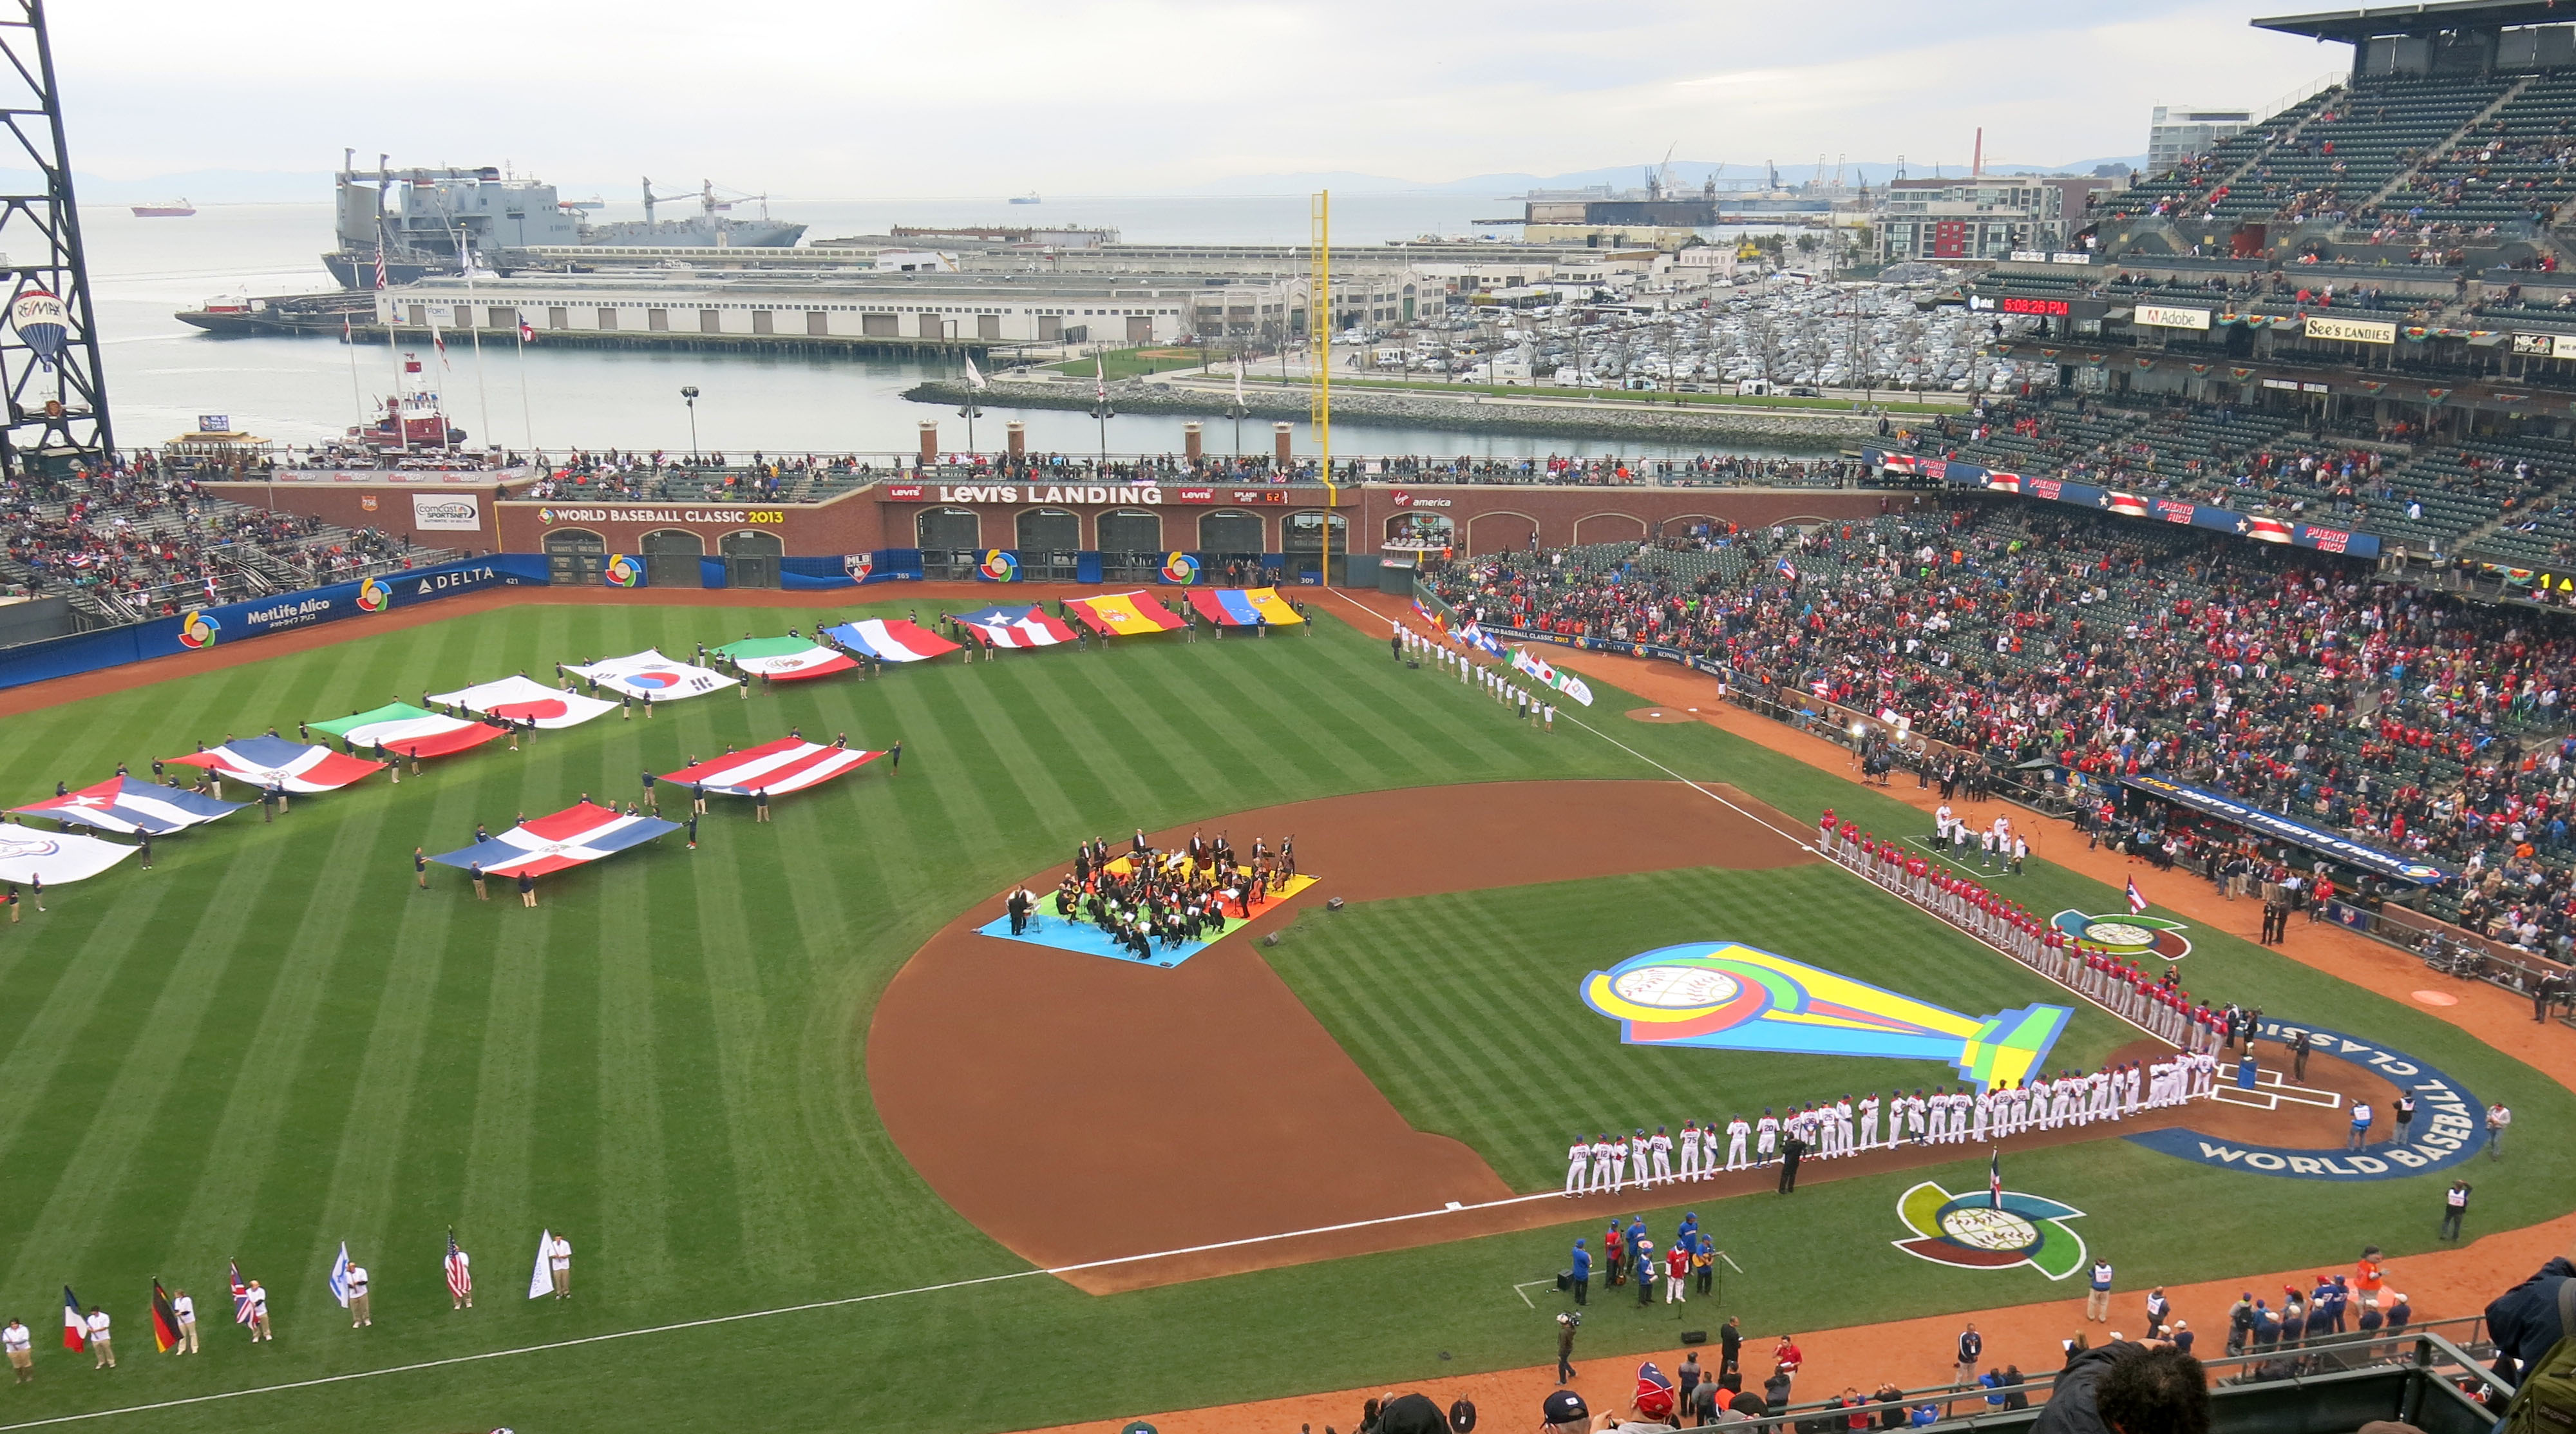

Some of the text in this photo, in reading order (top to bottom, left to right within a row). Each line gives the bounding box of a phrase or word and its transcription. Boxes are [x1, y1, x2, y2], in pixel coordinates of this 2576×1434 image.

[17, 300, 62, 318] RE/MAX
[2004, 298, 2069, 315] 5:08:26 PM
[2161, 311, 2195, 326] Adobe
[2309, 320, 2390, 341] See's CANDIES
[2515, 335, 2537, 346] NBC
[1919, 459, 1947, 471] PUERTO
[1927, 469, 1944, 479] RICO
[2029, 477, 2061, 492] PUERTO
[1028, 486, 1162, 504] LANDING
[1412, 498, 1452, 506] america
[2038, 490, 2059, 500] RICO
[2157, 499, 2194, 515] PUERTO
[555, 509, 784, 524] WORLD BASEBALL CLASSIC 2013
[2167, 513, 2191, 524] RICO
[2306, 526, 2349, 543] PUERTO
[2316, 539, 2346, 554] RICO
[847, 555, 869, 564] MLB
[436, 566, 495, 589] DELTA
[2540, 573, 2550, 589] 1
[248, 598, 330, 625] MetLife Alico
[1480, 626, 1500, 635] WORLD
[1501, 628, 1528, 638] BASEBALL
[1529, 633, 1553, 642] CLASSIC
[2137, 777, 2401, 866] WORLD BASEBALL CLASSIC 2013
[2199, 1142, 2389, 1174] WORLD
[2383, 1078, 2473, 1168] BASEBALL
